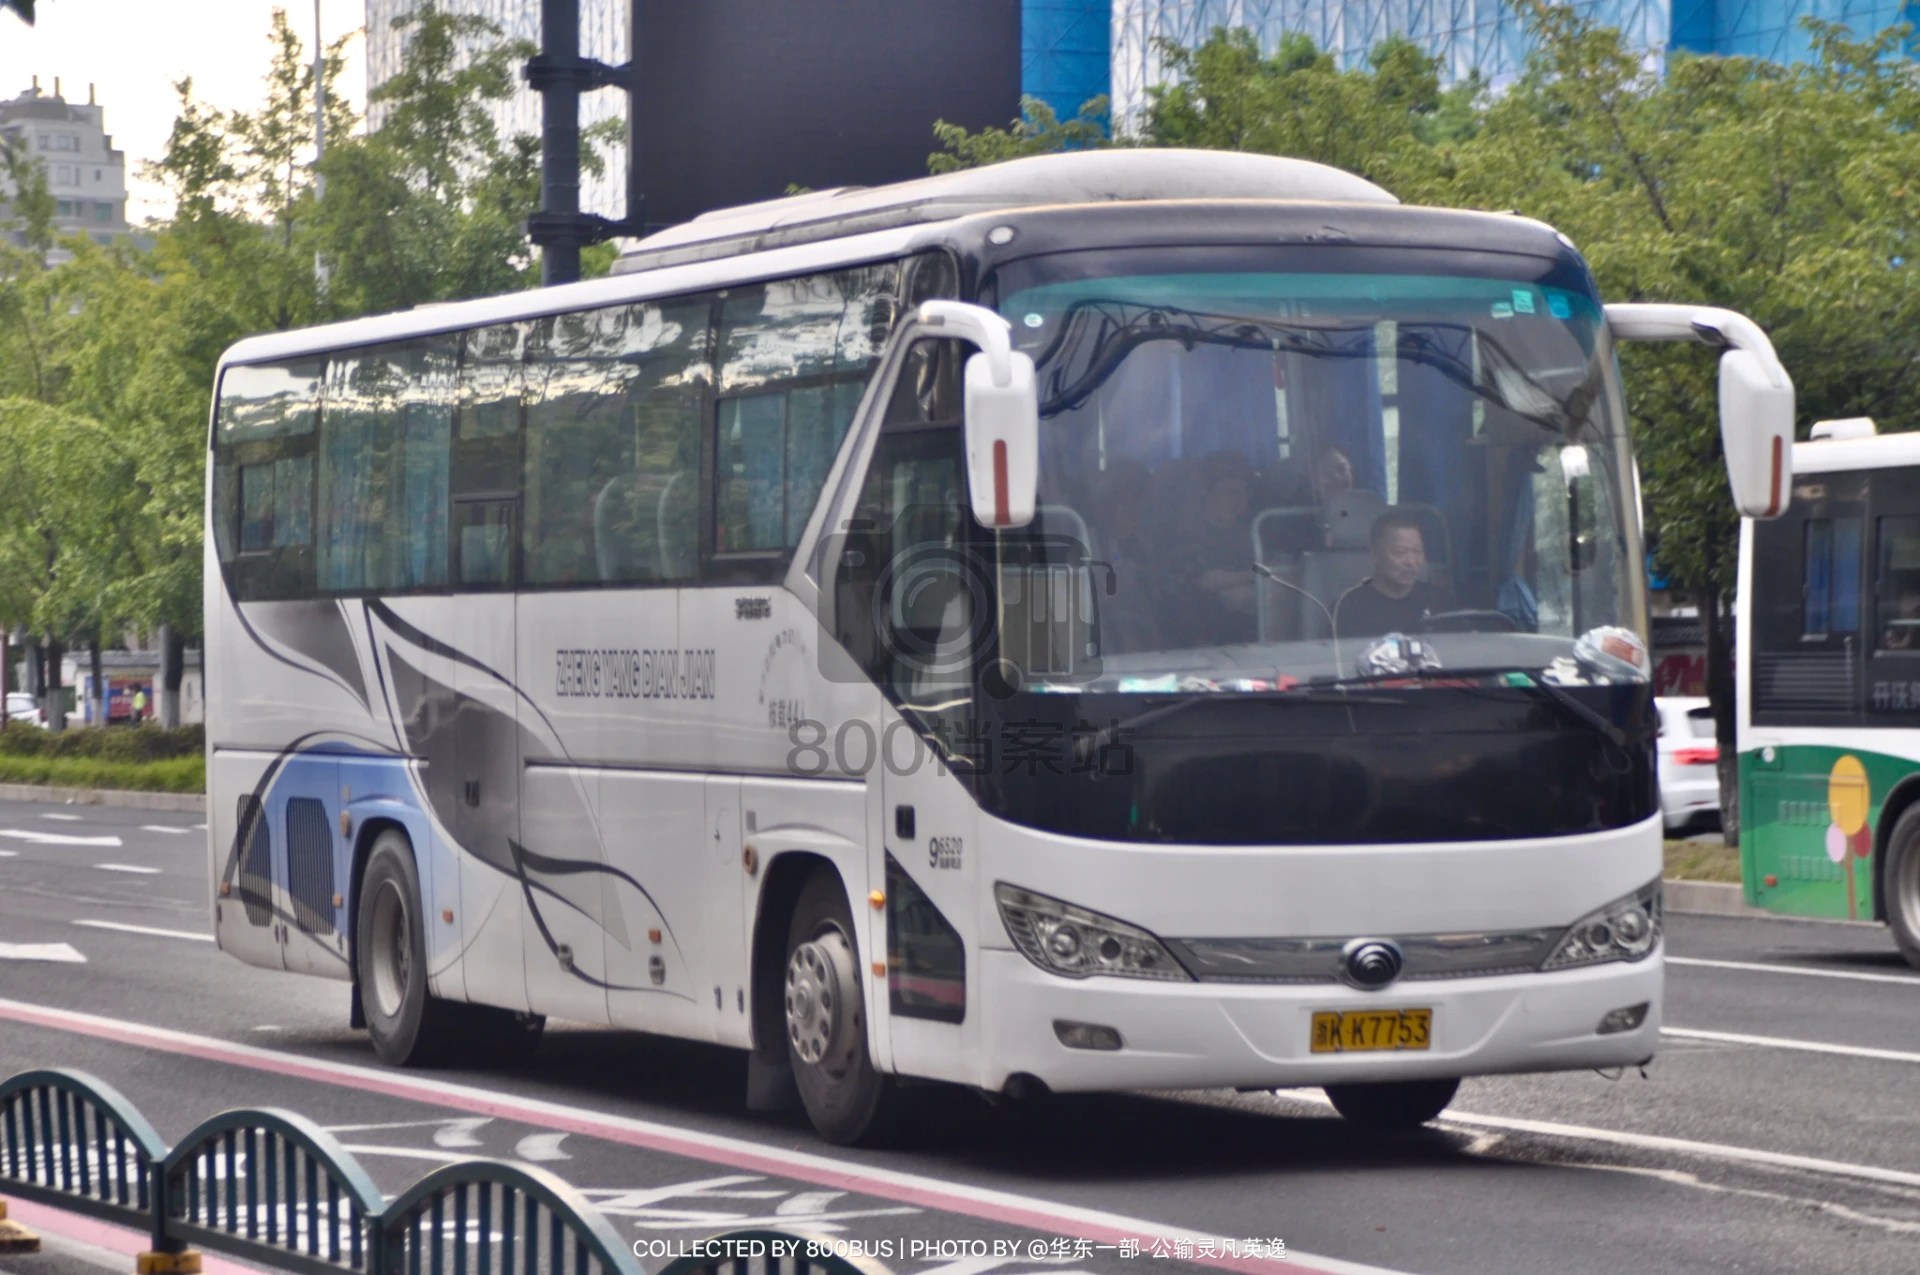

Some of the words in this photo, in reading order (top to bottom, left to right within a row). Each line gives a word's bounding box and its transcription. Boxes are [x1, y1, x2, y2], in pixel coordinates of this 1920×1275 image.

[556, 649, 601, 698] ZHENG
[602, 649, 640, 699] YANG
[642, 649, 678, 699] DIAN
[680, 649, 715, 700] JIAN
